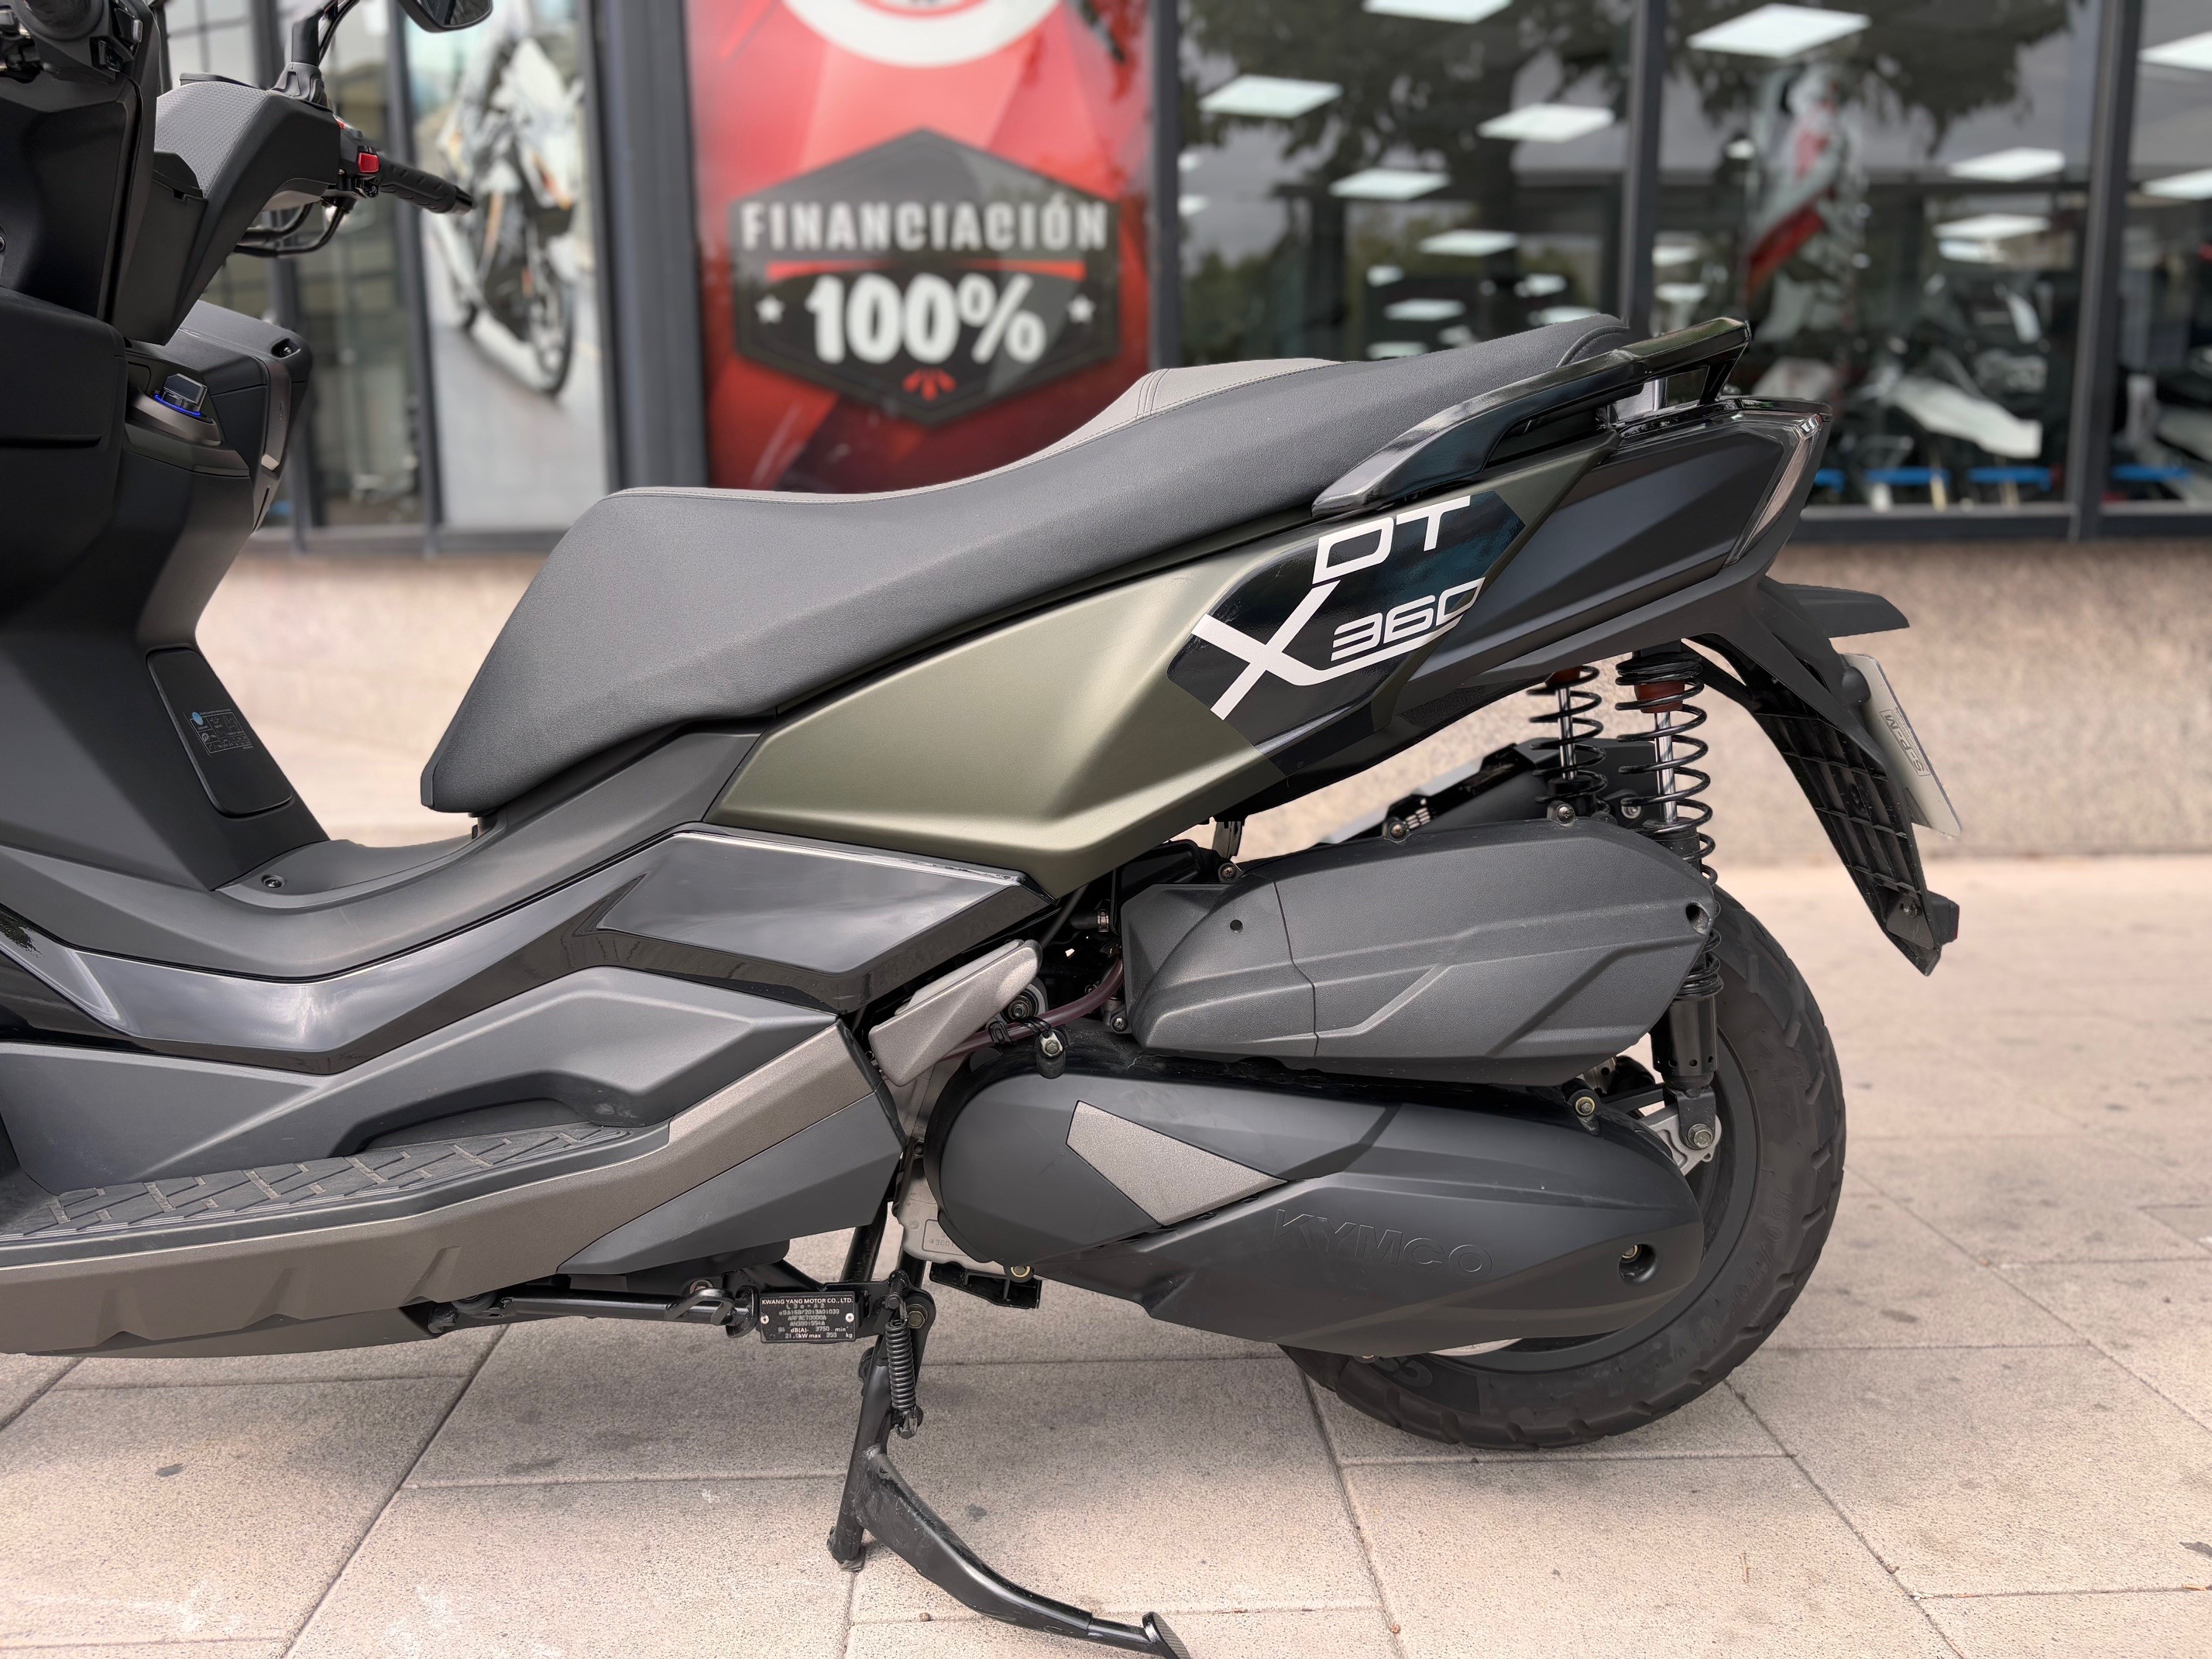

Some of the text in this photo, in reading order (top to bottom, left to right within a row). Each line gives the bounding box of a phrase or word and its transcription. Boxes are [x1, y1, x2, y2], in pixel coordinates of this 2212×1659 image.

[740, 194, 1108, 252] FINANCIACIÓN
[805, 273, 1046, 365] 100%
[1312, 496, 1470, 585] DT
[1273, 1208, 1493, 1281] KYMCO
